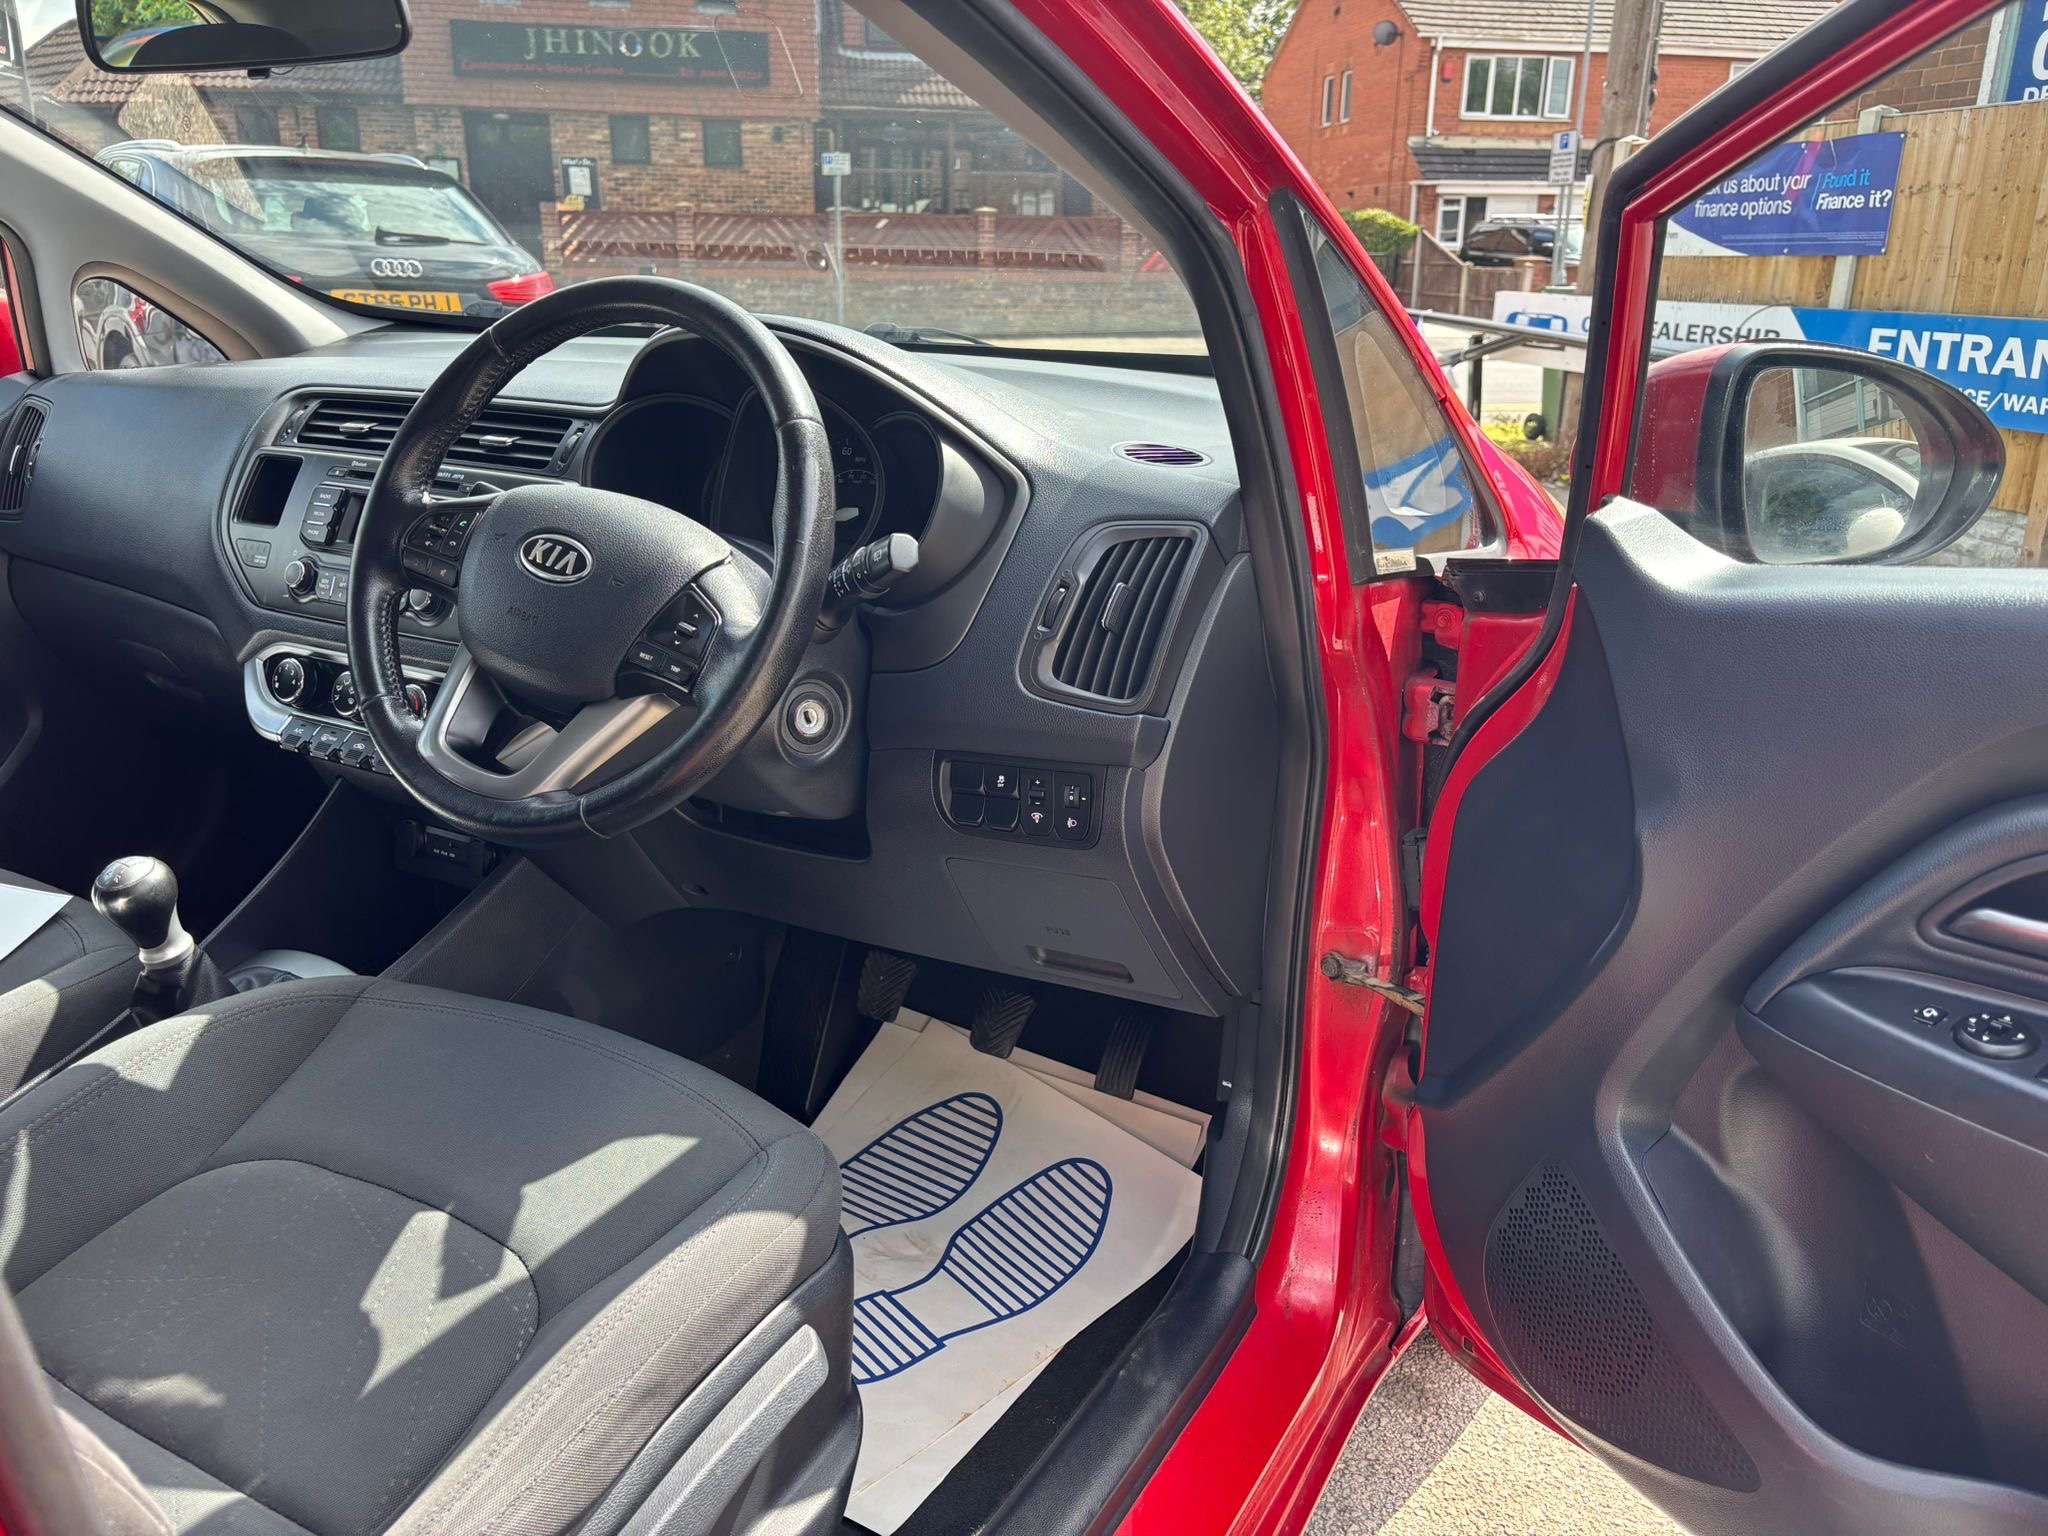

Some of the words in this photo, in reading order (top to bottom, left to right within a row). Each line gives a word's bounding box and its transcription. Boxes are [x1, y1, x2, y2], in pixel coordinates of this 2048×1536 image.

[524, 27, 701, 60] JHINOOK
[1723, 179, 1738, 194] us
[1740, 173, 1780, 193] about
[1859, 168, 1872, 186] it
[1694, 199, 1737, 218] finance
[1740, 197, 1792, 220] options
[1868, 188, 1892, 208] it?
[528, 539, 578, 575] KIA
